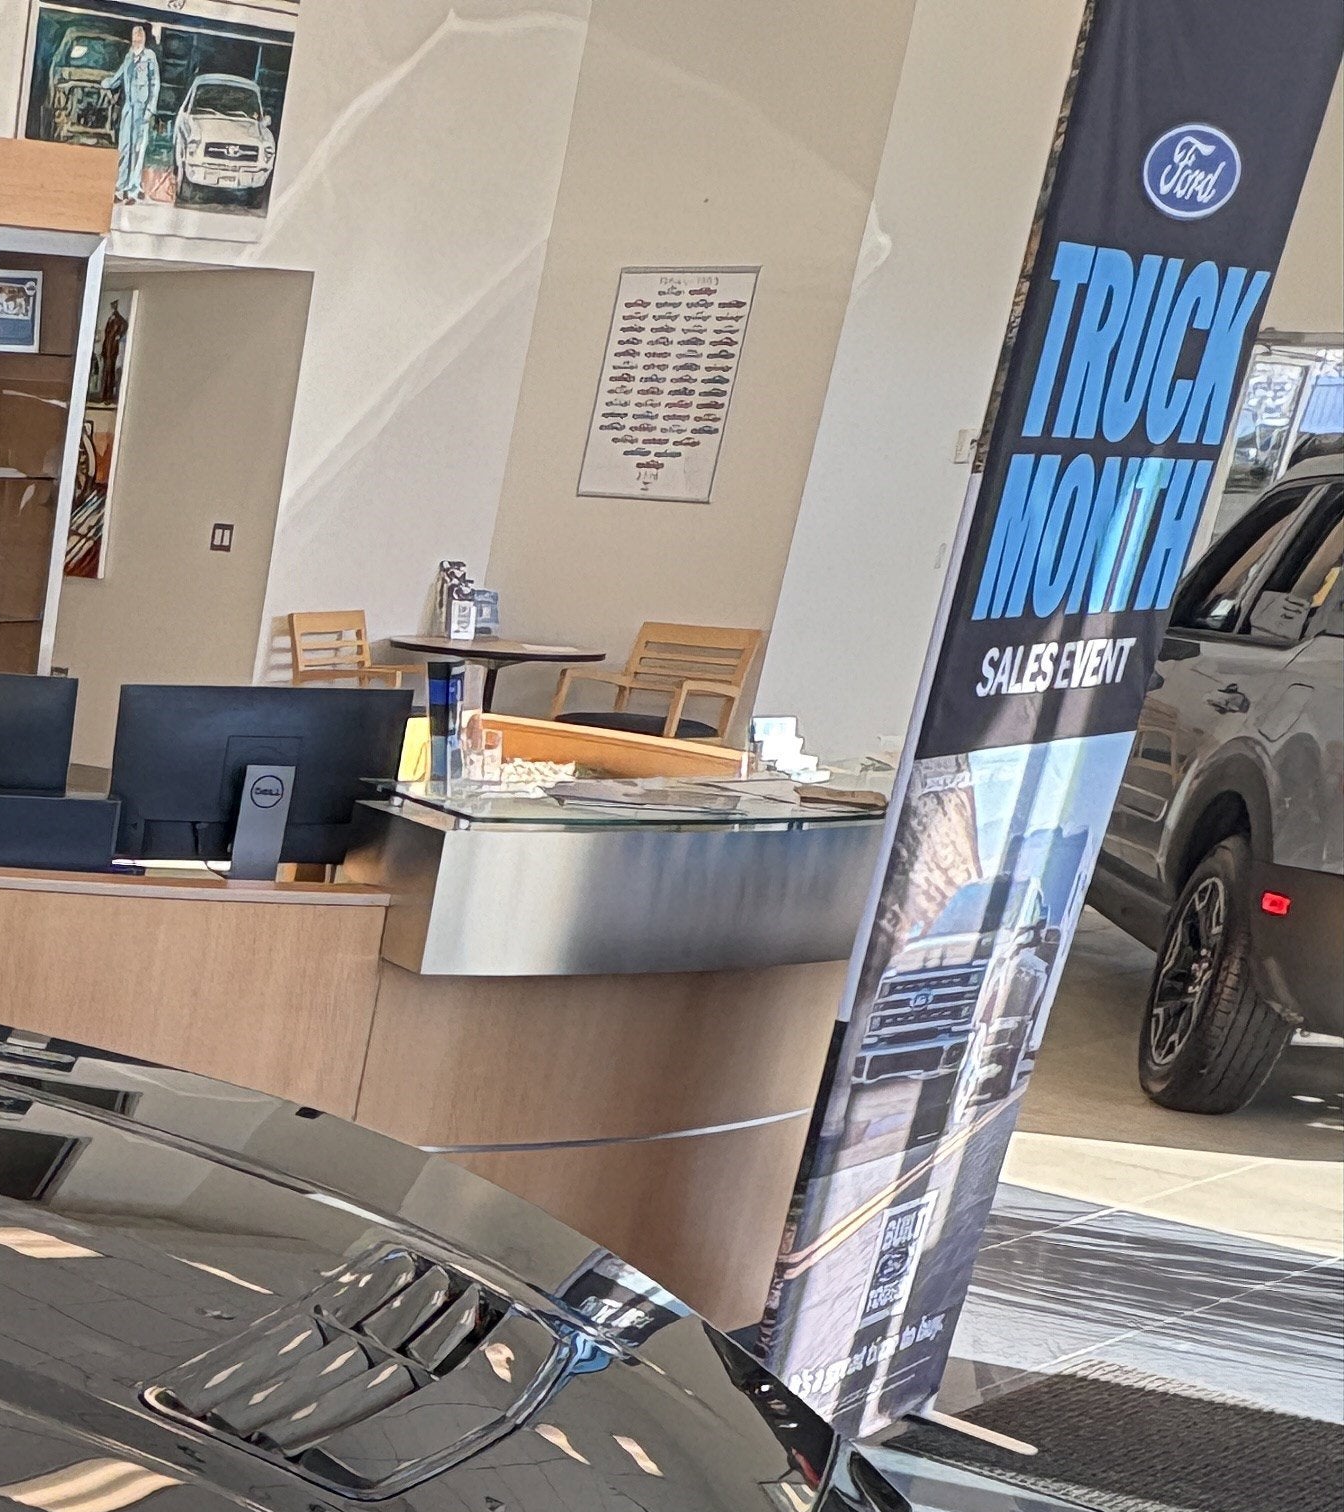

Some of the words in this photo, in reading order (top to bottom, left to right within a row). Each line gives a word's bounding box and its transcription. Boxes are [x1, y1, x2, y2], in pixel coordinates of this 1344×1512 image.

[1160, 136, 1226, 203] Ford
[1021, 241, 1271, 445] TRUCK
[971, 453, 1215, 620] MONTH
[976, 642, 1059, 697] SALES
[1053, 637, 1138, 689] EVENT
